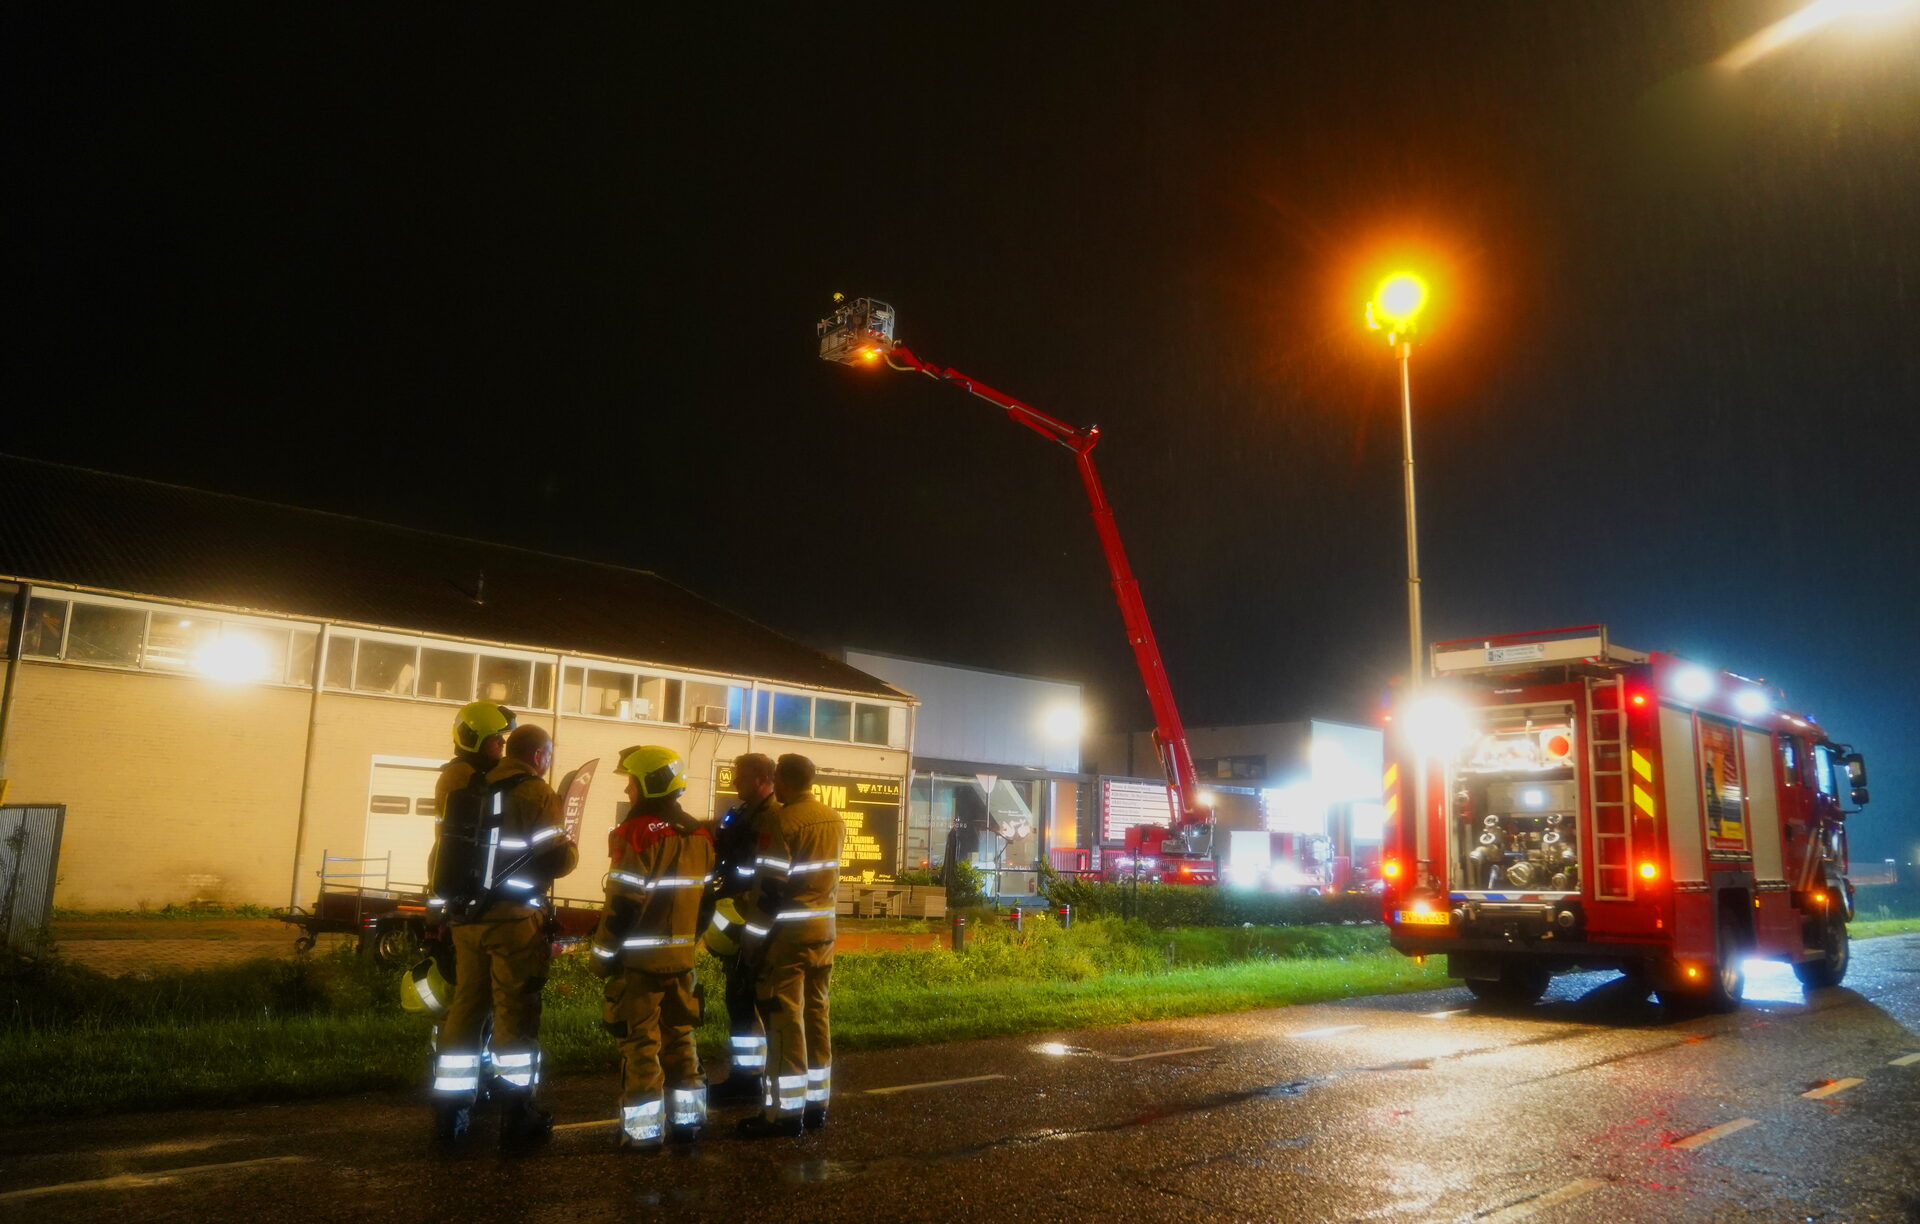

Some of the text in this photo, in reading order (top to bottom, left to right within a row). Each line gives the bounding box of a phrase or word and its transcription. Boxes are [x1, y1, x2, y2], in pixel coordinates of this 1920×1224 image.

[811, 784, 847, 808] GYM
[849, 836, 874, 844] TRAINING
[855, 844, 879, 852] TRAINING
[857, 852, 882, 860] TRAINING
